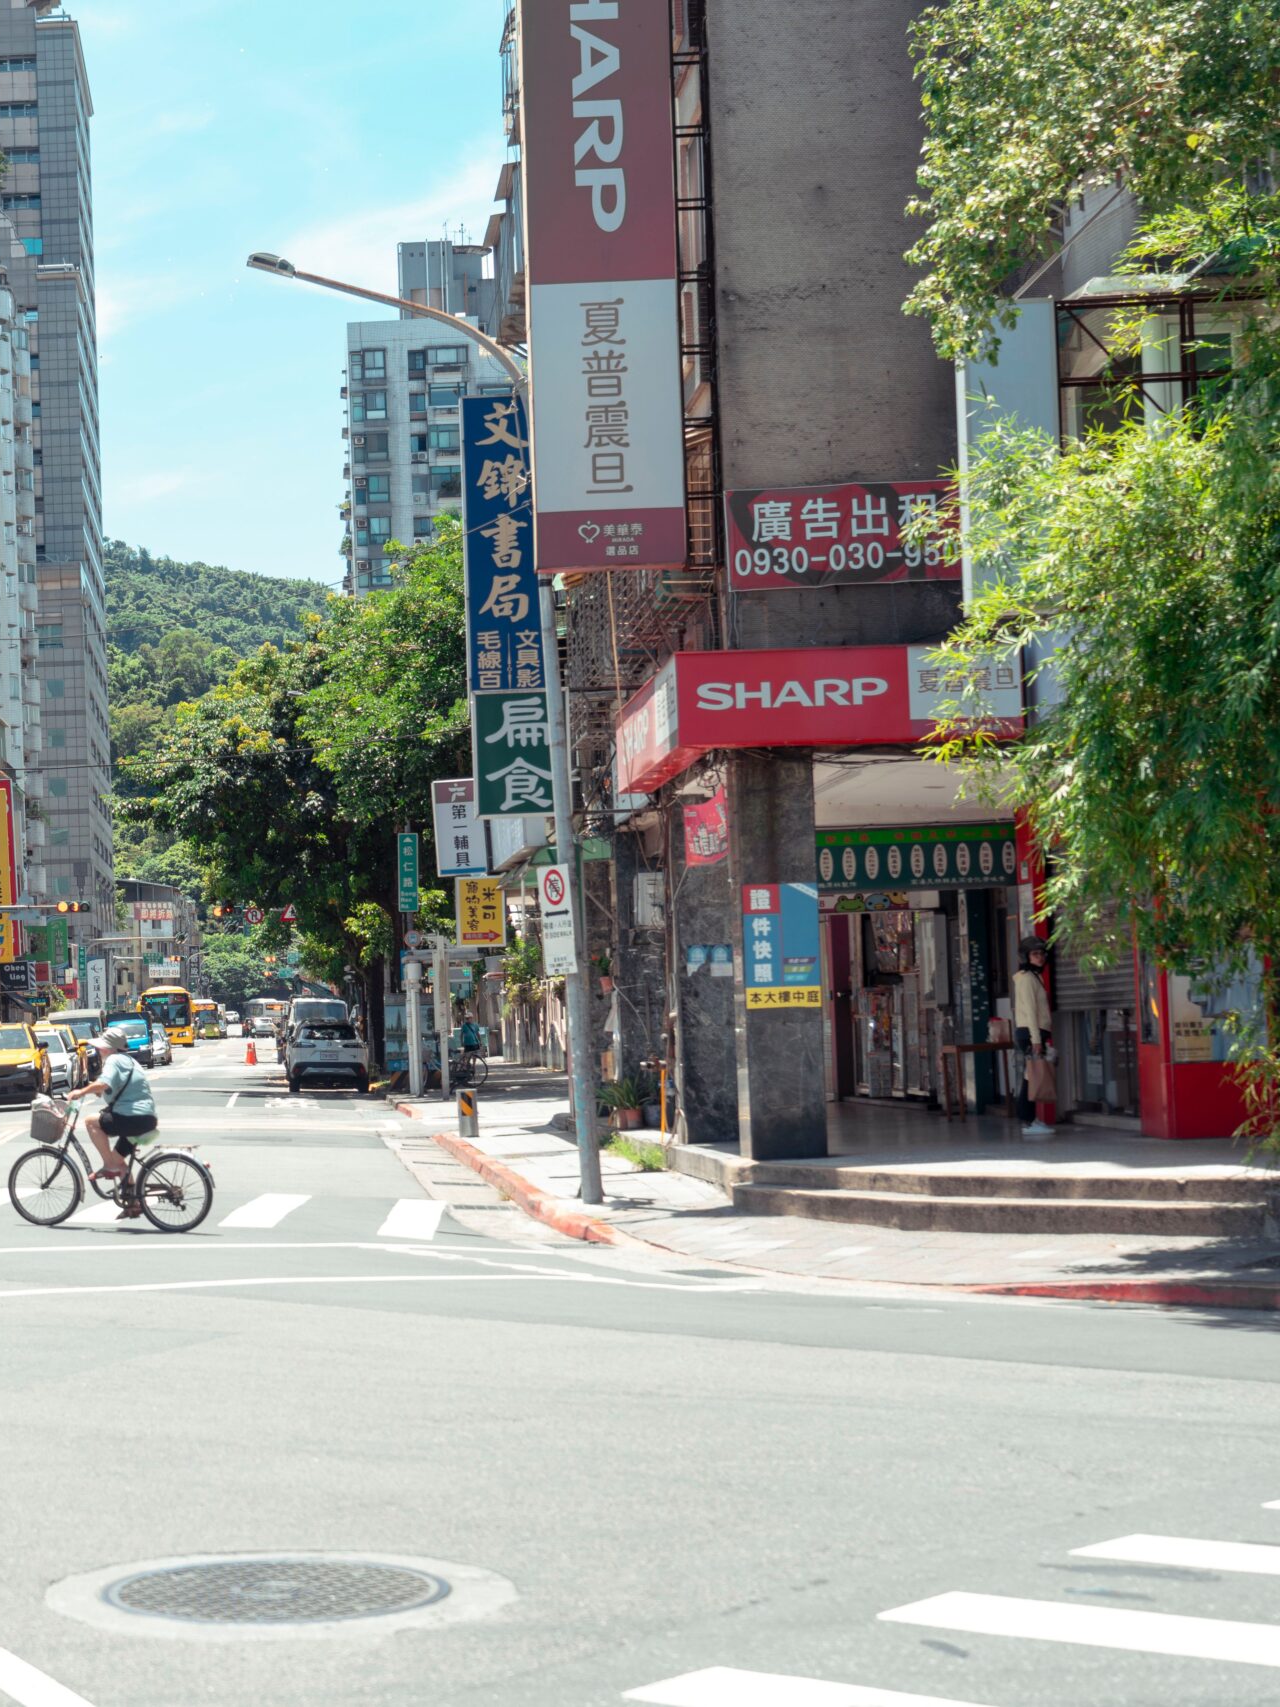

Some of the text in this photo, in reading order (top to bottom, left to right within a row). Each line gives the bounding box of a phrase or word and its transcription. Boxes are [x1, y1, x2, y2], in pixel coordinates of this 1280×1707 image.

[580, 298, 633, 494] 夏普震旦
[475, 402, 529, 623] 文錦書局
[696, 677, 888, 710] SHARP
[485, 696, 553, 811] 扁食
[452, 805, 470, 867] 第一輔具
[750, 888, 773, 983] 證件快照
[9, 973, 26, 981] Ling
[750, 990, 819, 1004] 本大樓中庭
